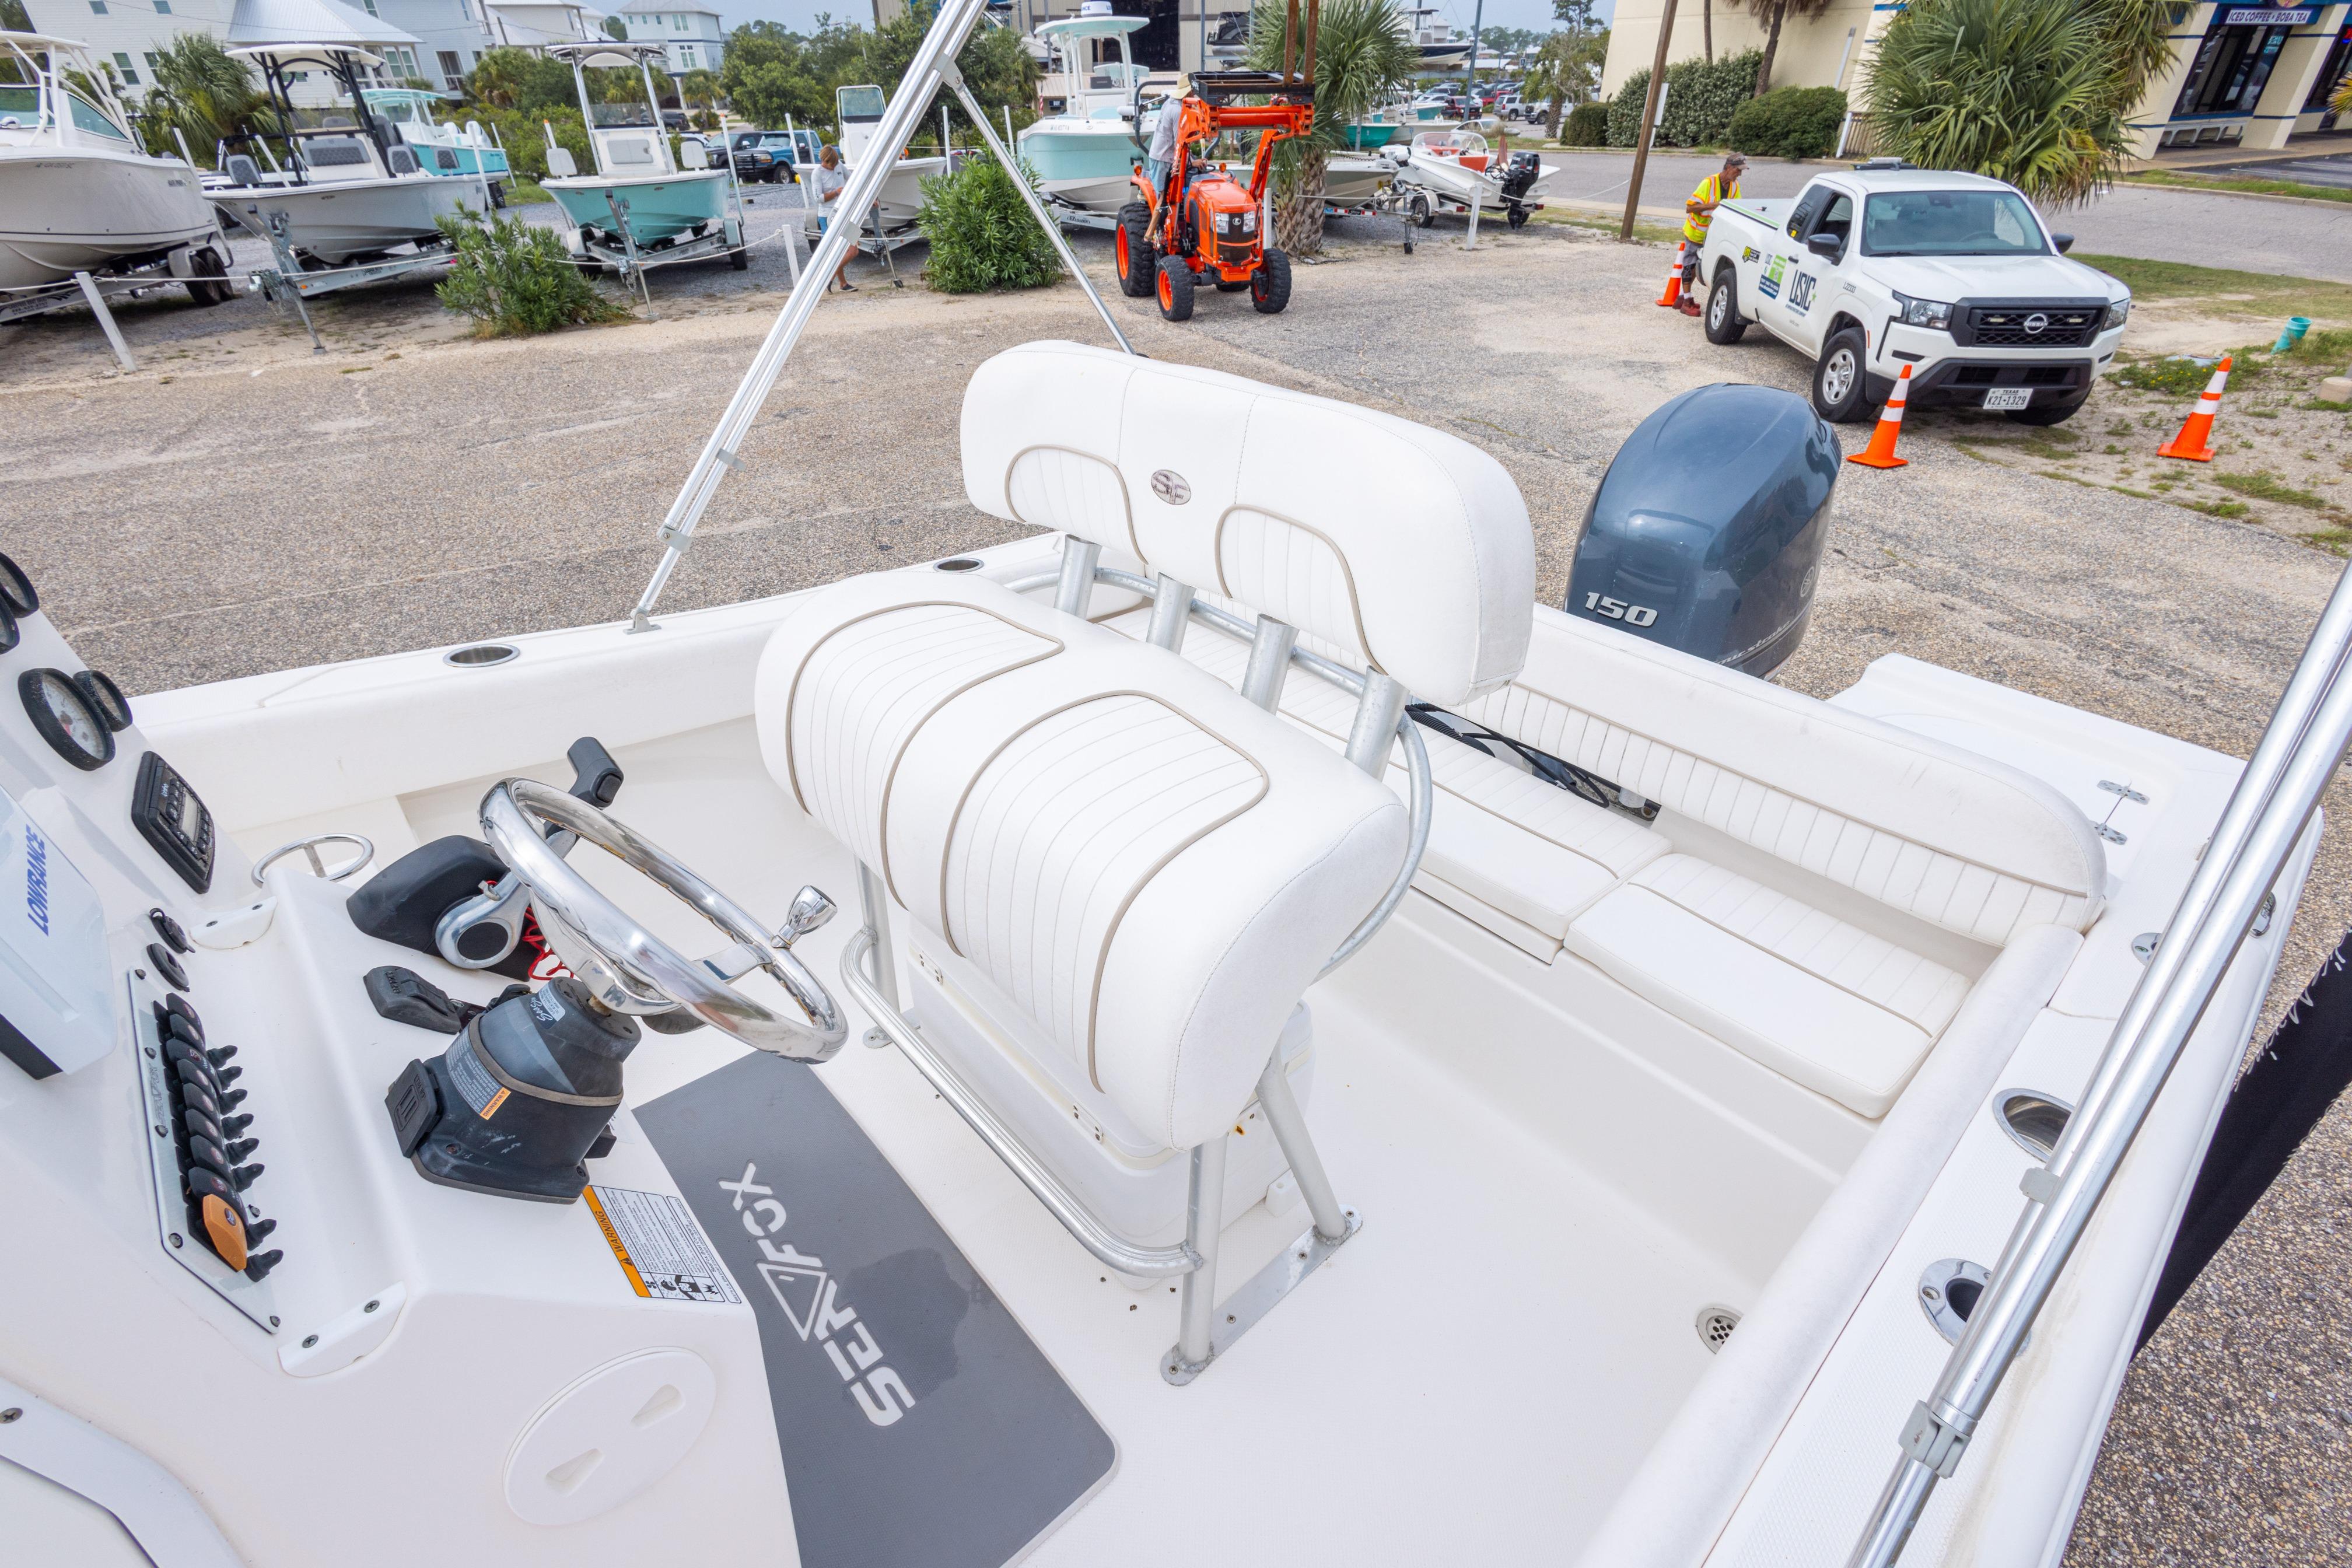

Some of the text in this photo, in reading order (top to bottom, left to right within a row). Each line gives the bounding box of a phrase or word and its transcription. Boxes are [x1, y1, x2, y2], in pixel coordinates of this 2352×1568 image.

[2228, 11, 2308, 22] ICED COFFEE BOBA TEA
[1788, 269, 1817, 312] USIC
[1584, 592, 1658, 627] 150
[26, 823, 49, 937] LOWRANCE
[482, 1094, 503, 1116] WARNING
[595, 1210, 624, 1252] WARNING
